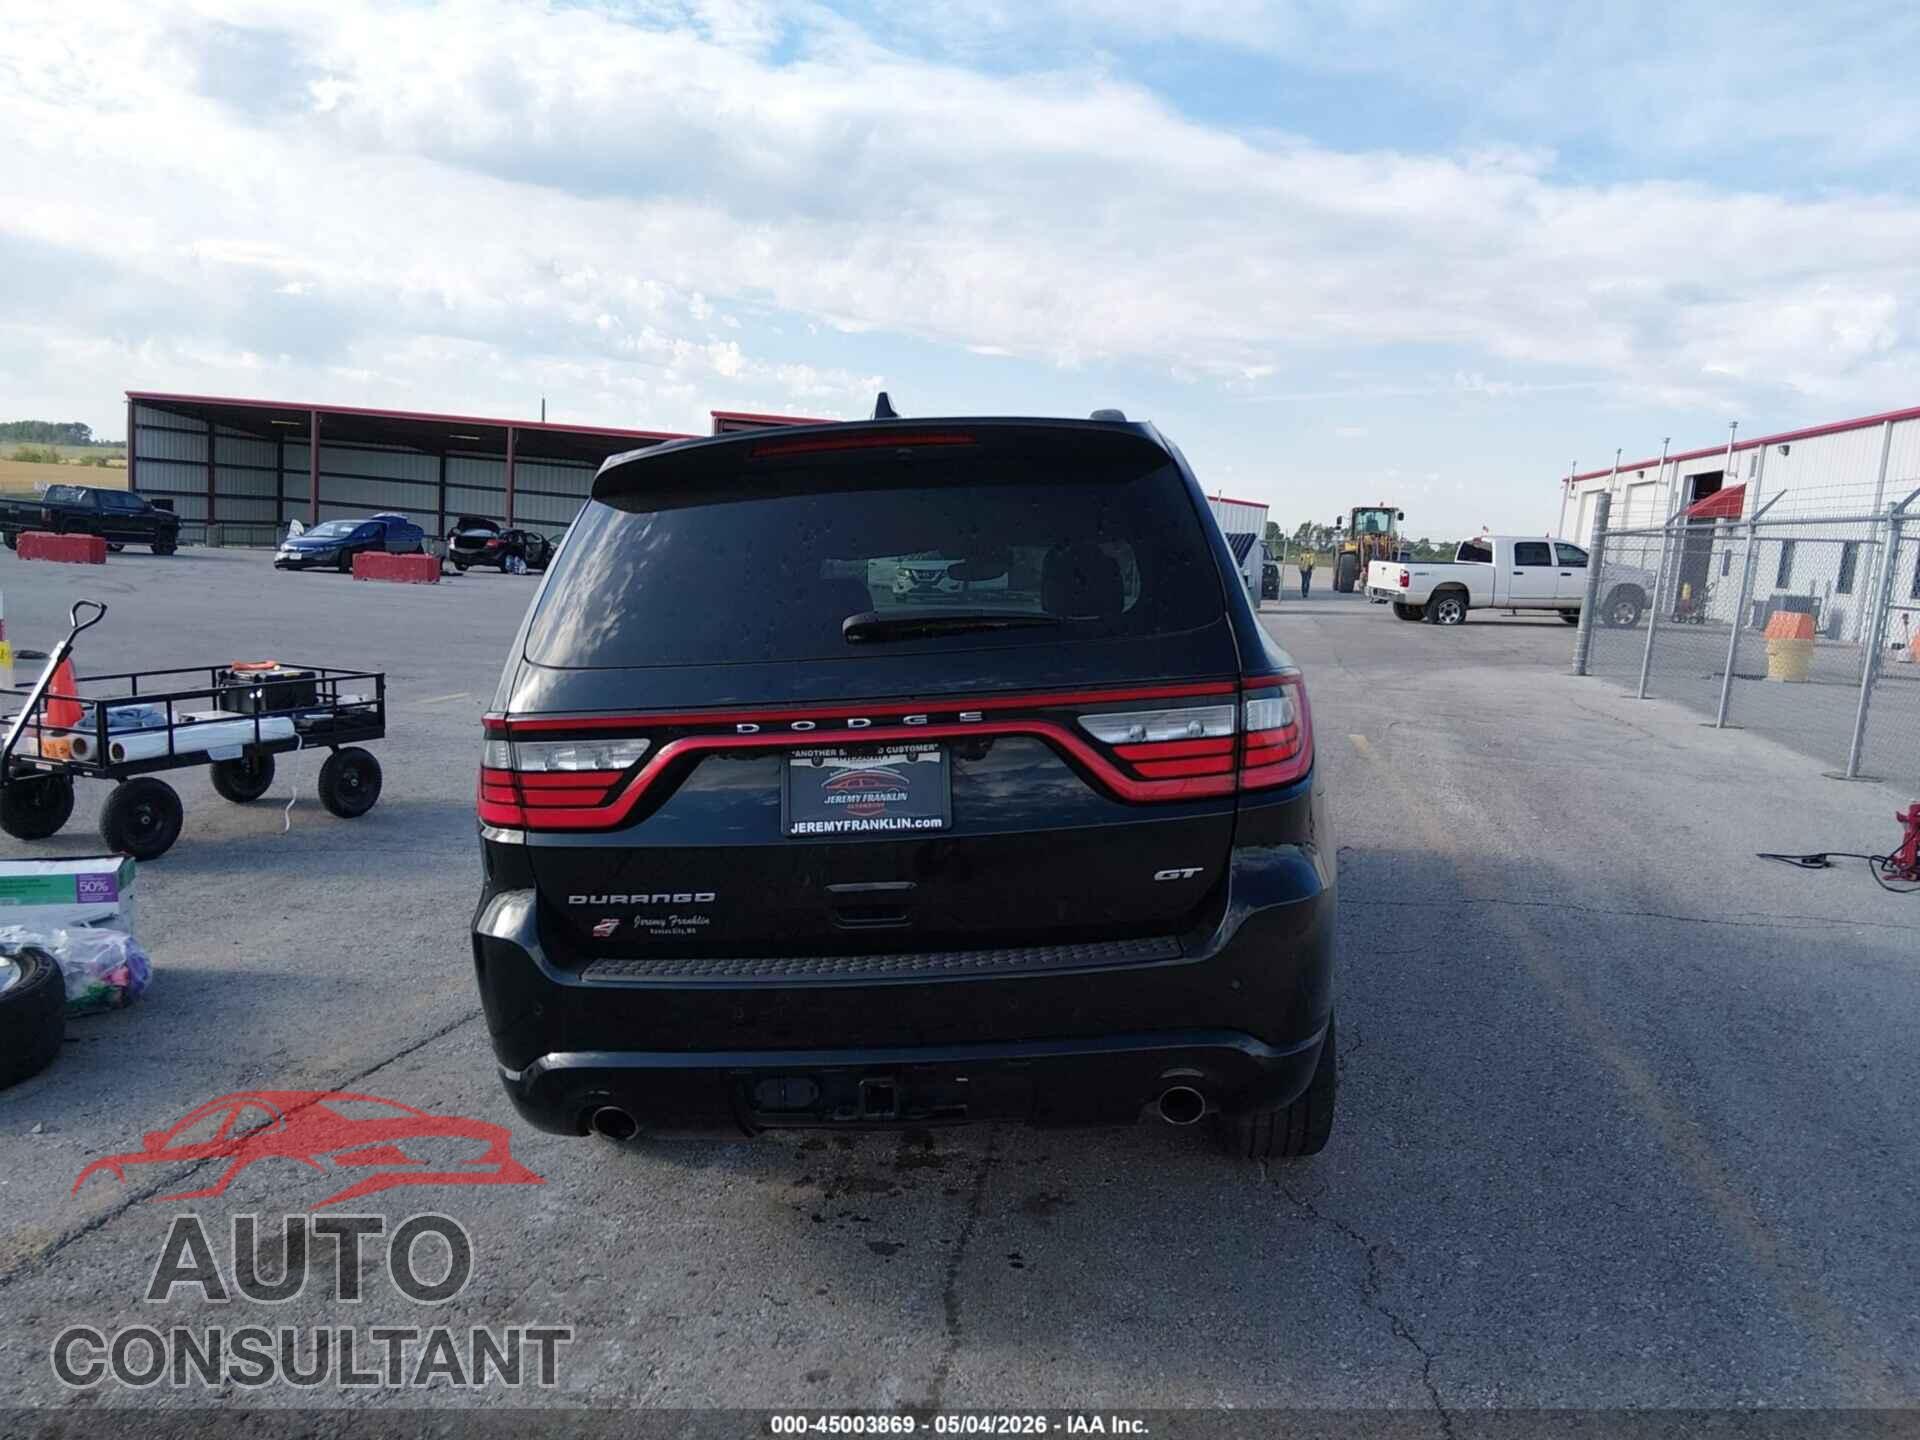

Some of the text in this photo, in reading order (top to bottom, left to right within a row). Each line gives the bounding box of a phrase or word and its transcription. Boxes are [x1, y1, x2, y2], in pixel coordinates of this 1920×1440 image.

[736, 711, 983, 734] DODGE
[824, 792, 908, 804] JEREMY FRANKLIN
[790, 817, 943, 834] JEREMYFRANKLIN.com
[1154, 867, 1204, 881] GT
[79, 881, 109, 893] 50%
[568, 892, 716, 904] DURANGO
[633, 914, 710, 928] Jeremy Franklin
